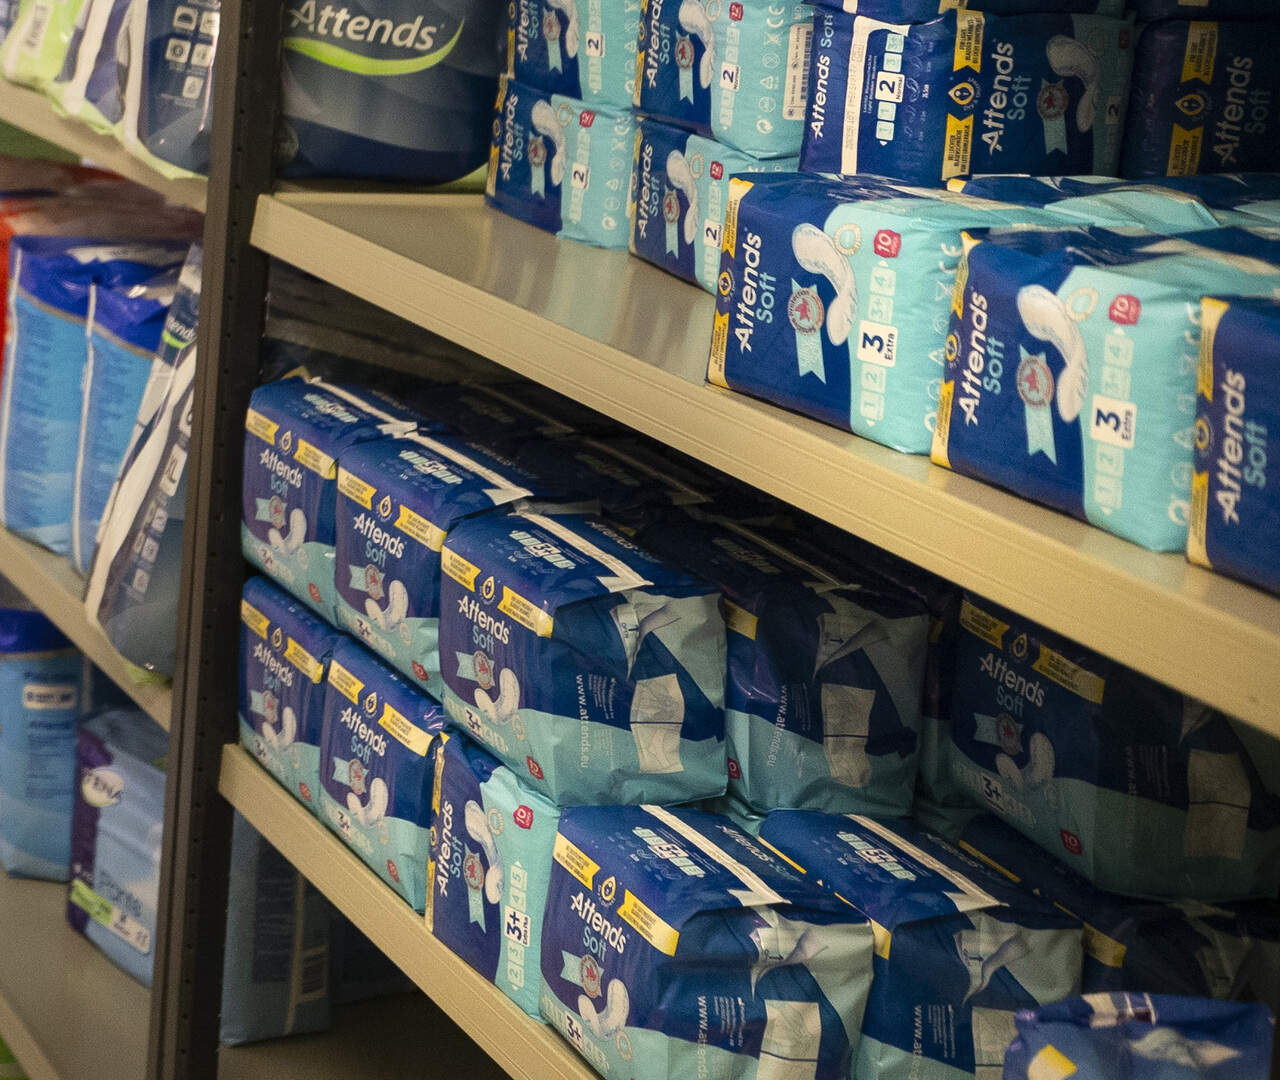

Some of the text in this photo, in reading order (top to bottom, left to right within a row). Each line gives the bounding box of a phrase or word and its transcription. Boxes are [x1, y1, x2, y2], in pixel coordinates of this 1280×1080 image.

[289, 0, 438, 52] Attends
[659, 22, 670, 64] Soft
[811, 54, 831, 140] Attends
[895, 76, 904, 101] Normal
[981, 41, 1014, 156] Attends
[1006, 75, 1032, 121] Soft
[1213, 56, 1253, 167] Attends
[1245, 89, 1271, 135] Soft
[501, 93, 519, 181] Attends
[513, 123, 524, 161] Soft
[638, 143, 654, 239] Attends
[648, 176, 661, 218] Soft
[877, 231, 893, 252] 10
[734, 231, 762, 354] Attends
[756, 272, 777, 324] Soft
[1113, 297, 1129, 319] 10
[862, 331, 885, 353] 3
[884, 332, 896, 361] Extra
[959, 290, 989, 427] Attends
[984, 336, 1005, 396] Soft
[1095, 407, 1121, 434] 3
[1121, 409, 1133, 442] Extra
[259, 448, 303, 490] Attends
[1216, 368, 1246, 524] Attends
[1243, 420, 1268, 489] Soft
[352, 512, 406, 559] Attends
[365, 540, 387, 567] Soft
[457, 595, 511, 645] Attends
[472, 626, 496, 655] Soft
[253, 642, 293, 687] Attends
[977, 653, 1048, 707] Attends
[996, 684, 1024, 718] Soft
[341, 707, 388, 757] Attends
[350, 735, 372, 763] Soft
[515, 808, 527, 826] 10
[437, 800, 454, 897] Attends
[450, 836, 464, 878] Soft
[505, 910, 524, 941] 3+
[570, 891, 628, 955] Attends
[582, 928, 607, 963] Soft
[696, 994, 708, 1080] www.attends
